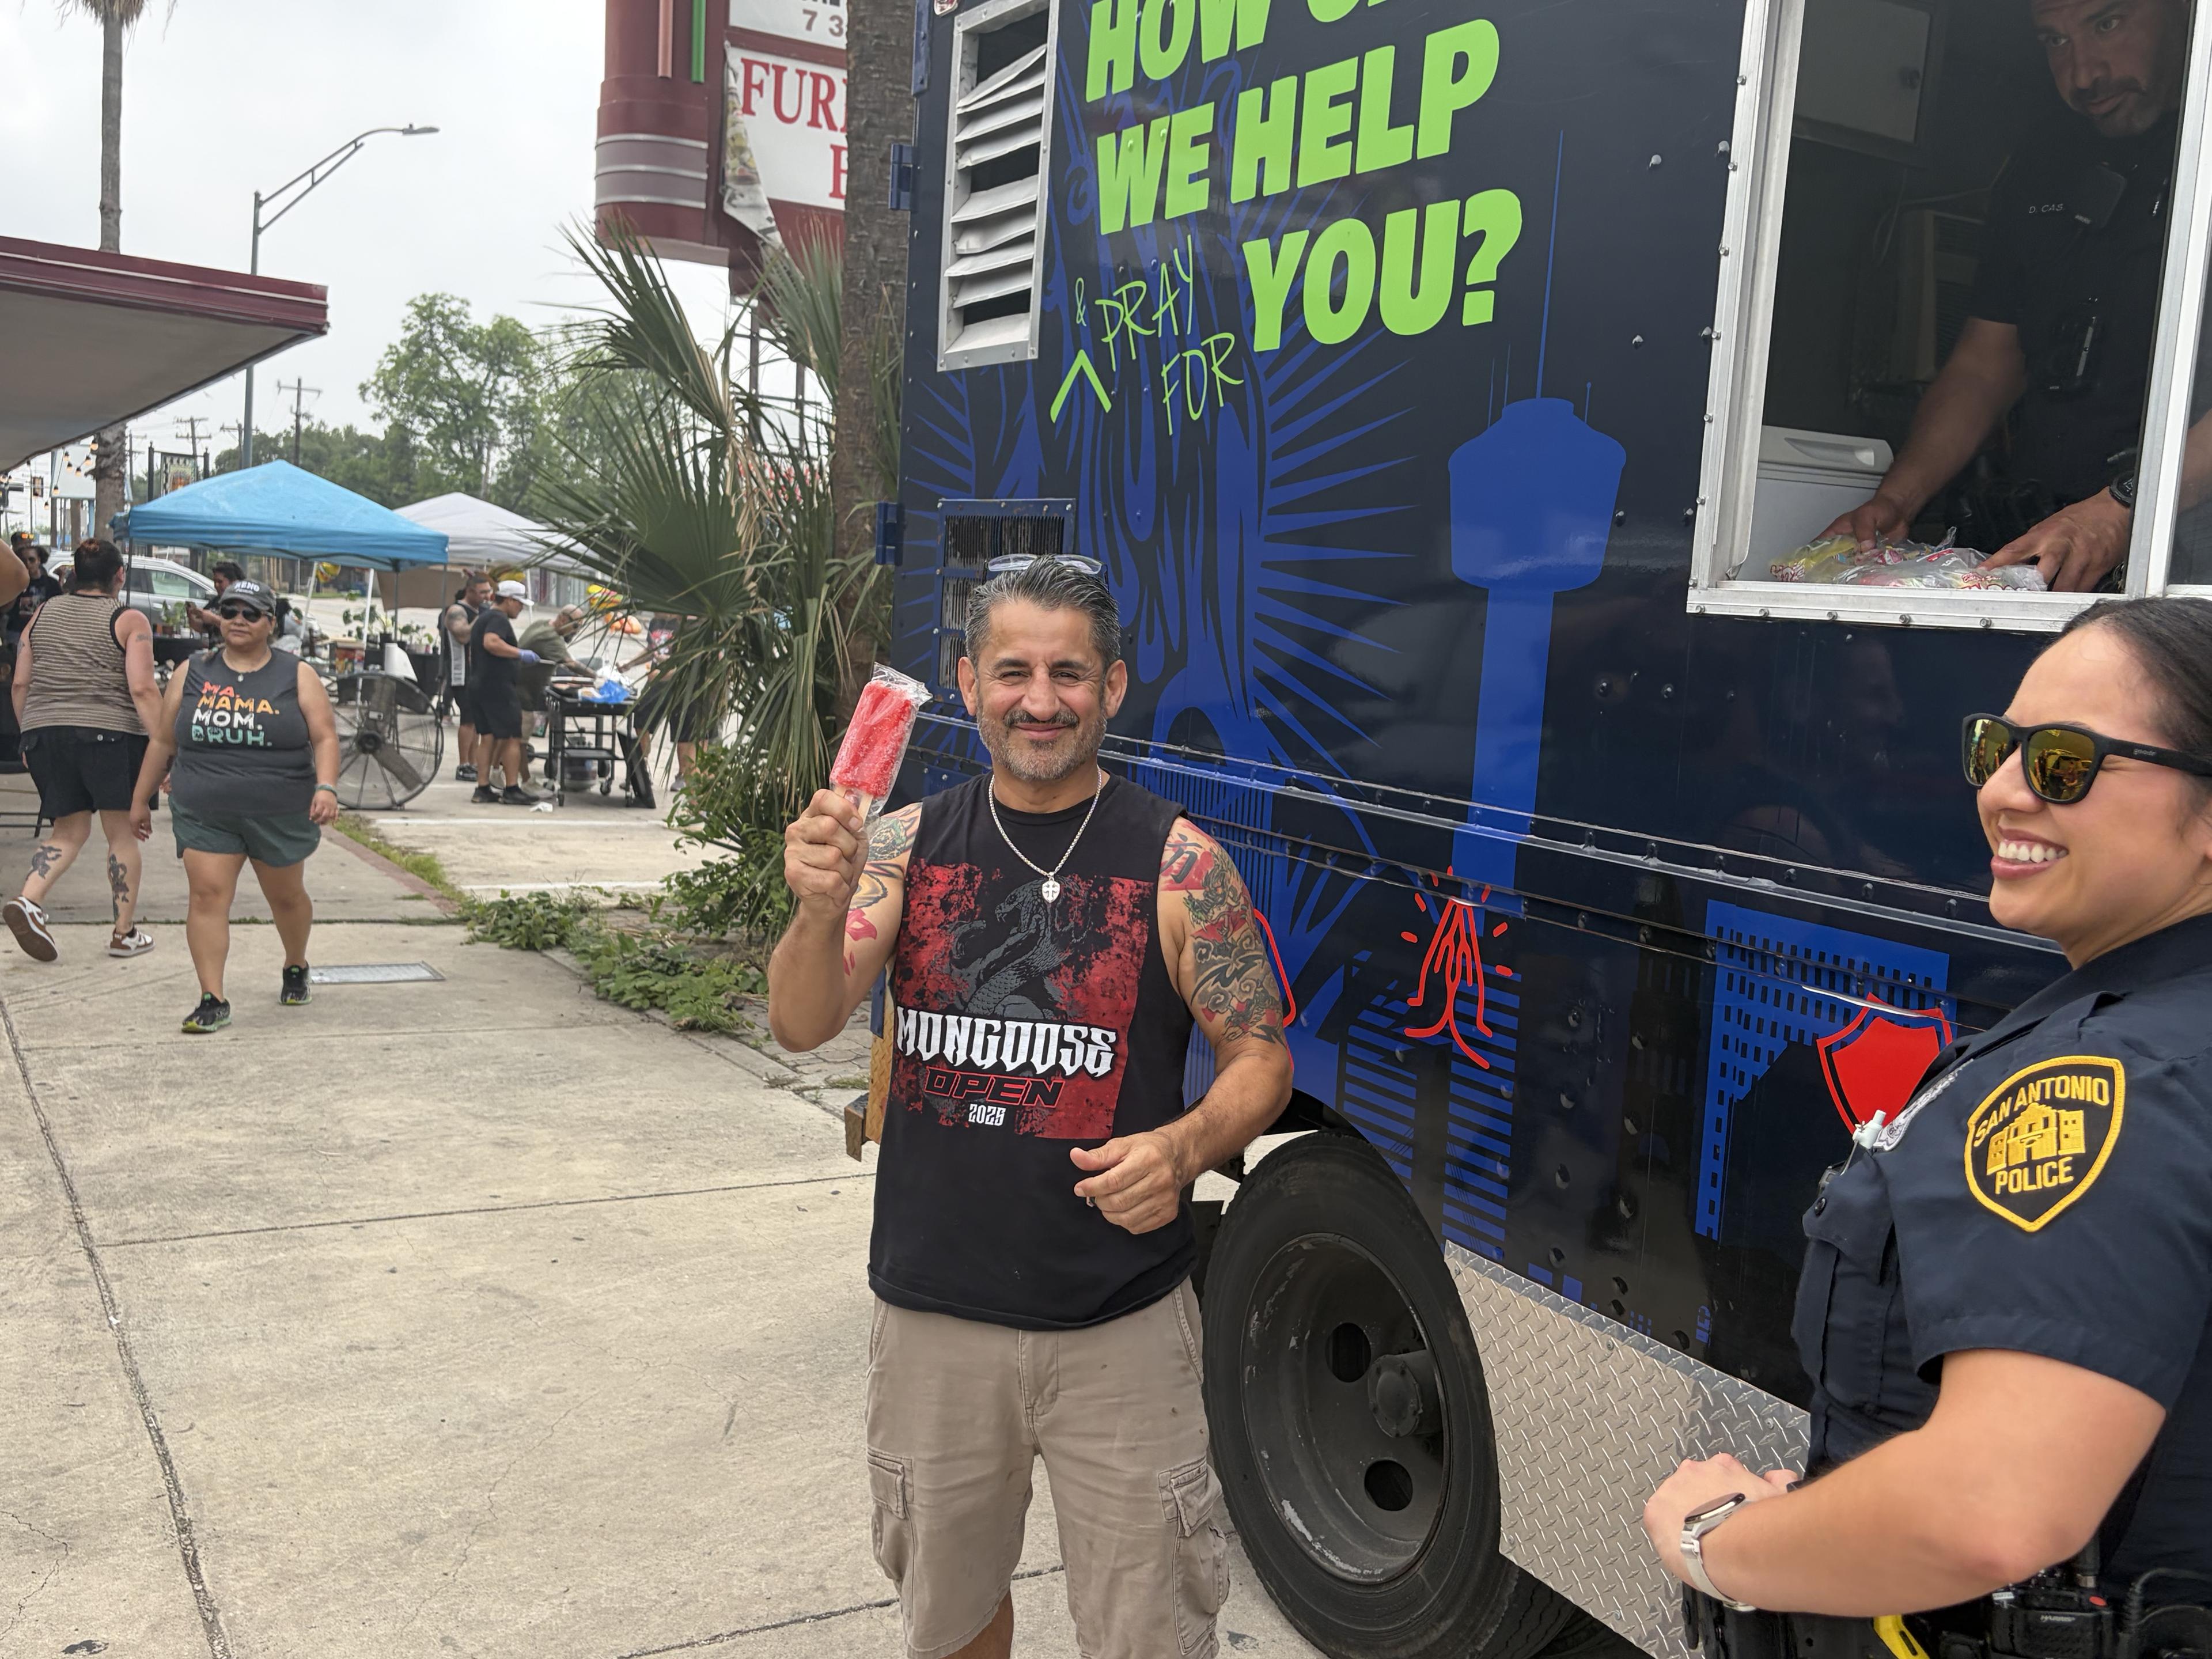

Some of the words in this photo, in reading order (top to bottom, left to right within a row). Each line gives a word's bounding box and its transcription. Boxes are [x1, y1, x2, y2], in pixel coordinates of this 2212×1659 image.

[1086, 0, 1270, 103] HOW
[740, 58, 847, 134] FUR
[1097, 102, 1214, 235] WE
[1231, 19, 1499, 204] HELP
[1094, 234, 1194, 372] PRAY
[1242, 188, 1522, 352] YOU?
[1161, 332, 1244, 436] FOR
[192, 708, 263, 730] MOM.
[198, 695, 280, 714] MAMA.
[201, 681, 240, 698] MA.
[192, 725, 272, 747] BRUH.
[896, 1006, 1116, 1077] MONGOOSE
[924, 1067, 1065, 1108] OPEN
[1974, 1096, 2012, 1147] SAN
[2014, 1075, 2109, 1111] ANTONIO
[1995, 1156, 2074, 1195] POLICE
